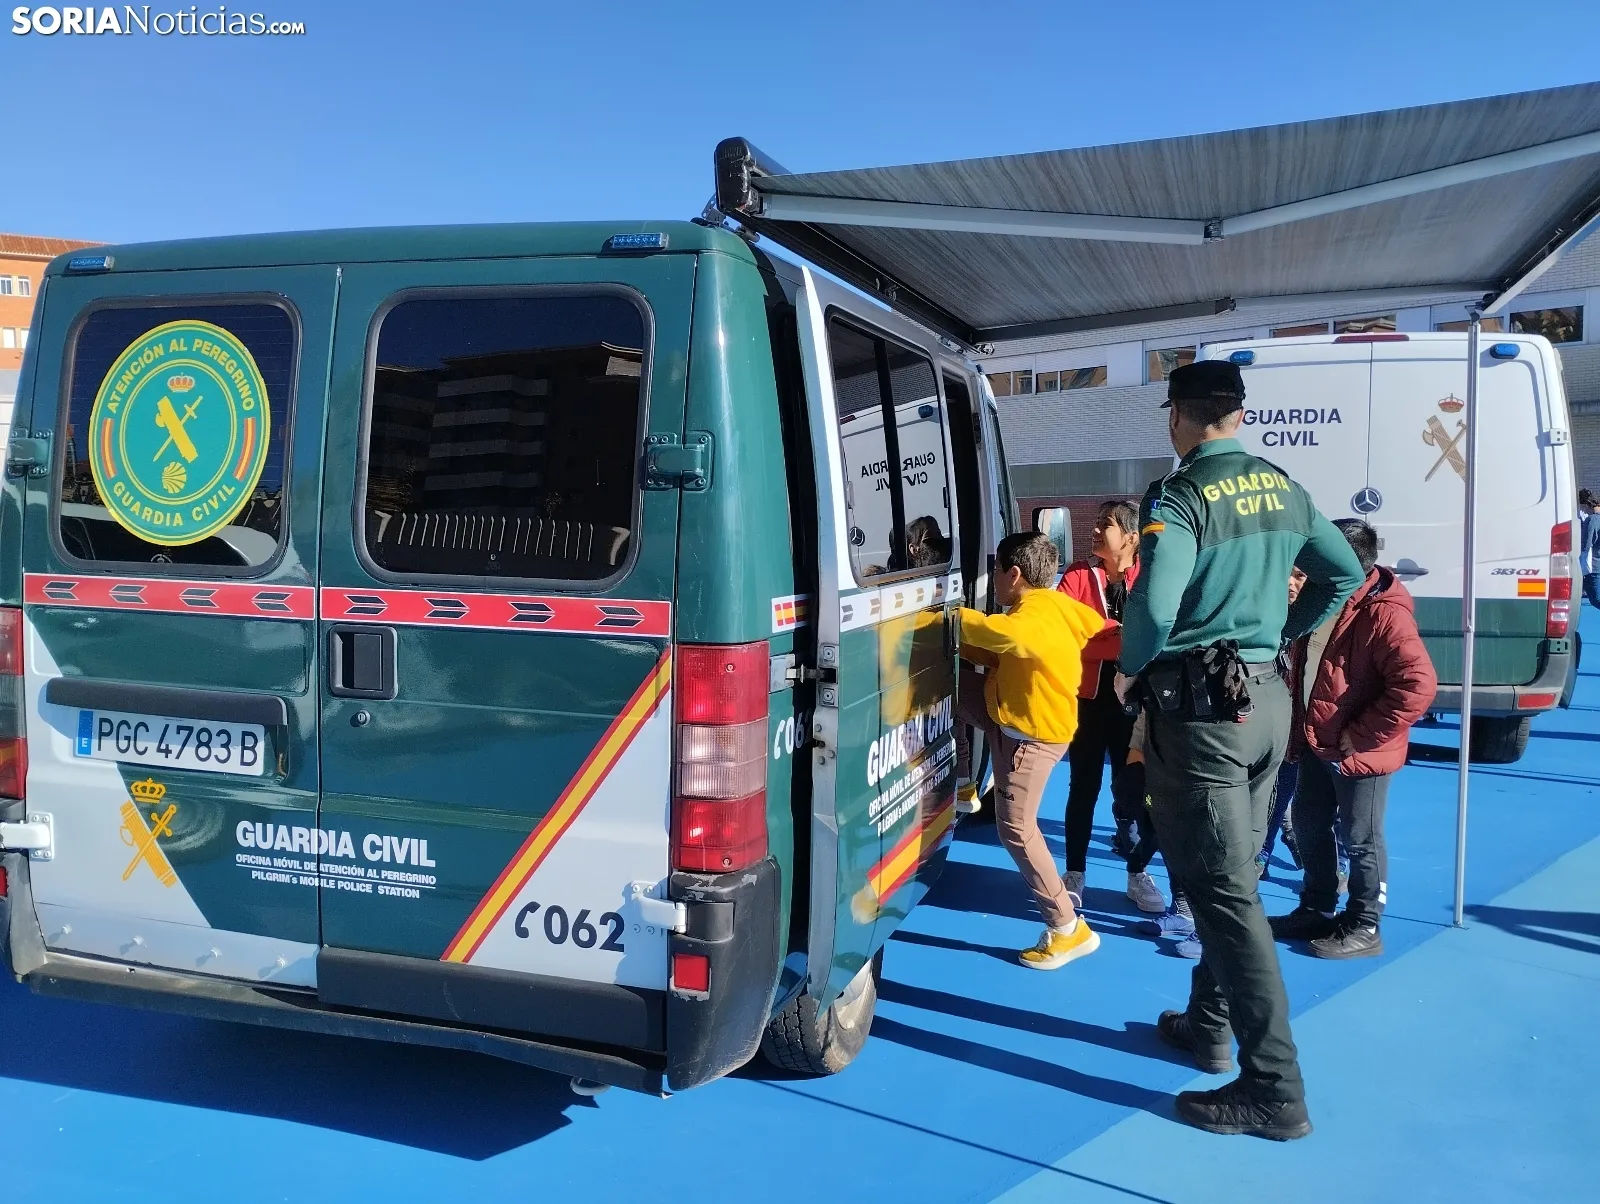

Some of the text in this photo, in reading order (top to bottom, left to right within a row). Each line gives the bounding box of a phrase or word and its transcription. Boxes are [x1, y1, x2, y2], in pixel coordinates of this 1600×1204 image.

[107, 338, 255, 414] ATENCIÓN AL PEREGRINO
[1242, 408, 1342, 426] GUARDIA
[1262, 430, 1319, 447] CIVIL
[113, 481, 236, 526] GUARDIA CIVIL
[1203, 472, 1291, 502] GUARDIA
[1236, 493, 1284, 516] CIVIL
[81, 737, 89, 748] E
[97, 717, 259, 767] PGC 4783 B
[867, 695, 954, 787] GUARDIA CIVIL
[236, 820, 436, 868] GUARDIA CIVIL
[236, 853, 437, 886] OFICINA MÓVIL DE ATENCIÓN AL PEREGRINO
[337, 881, 373, 894] POLICE
[378, 884, 420, 899] STATION
[543, 904, 625, 953] 062
